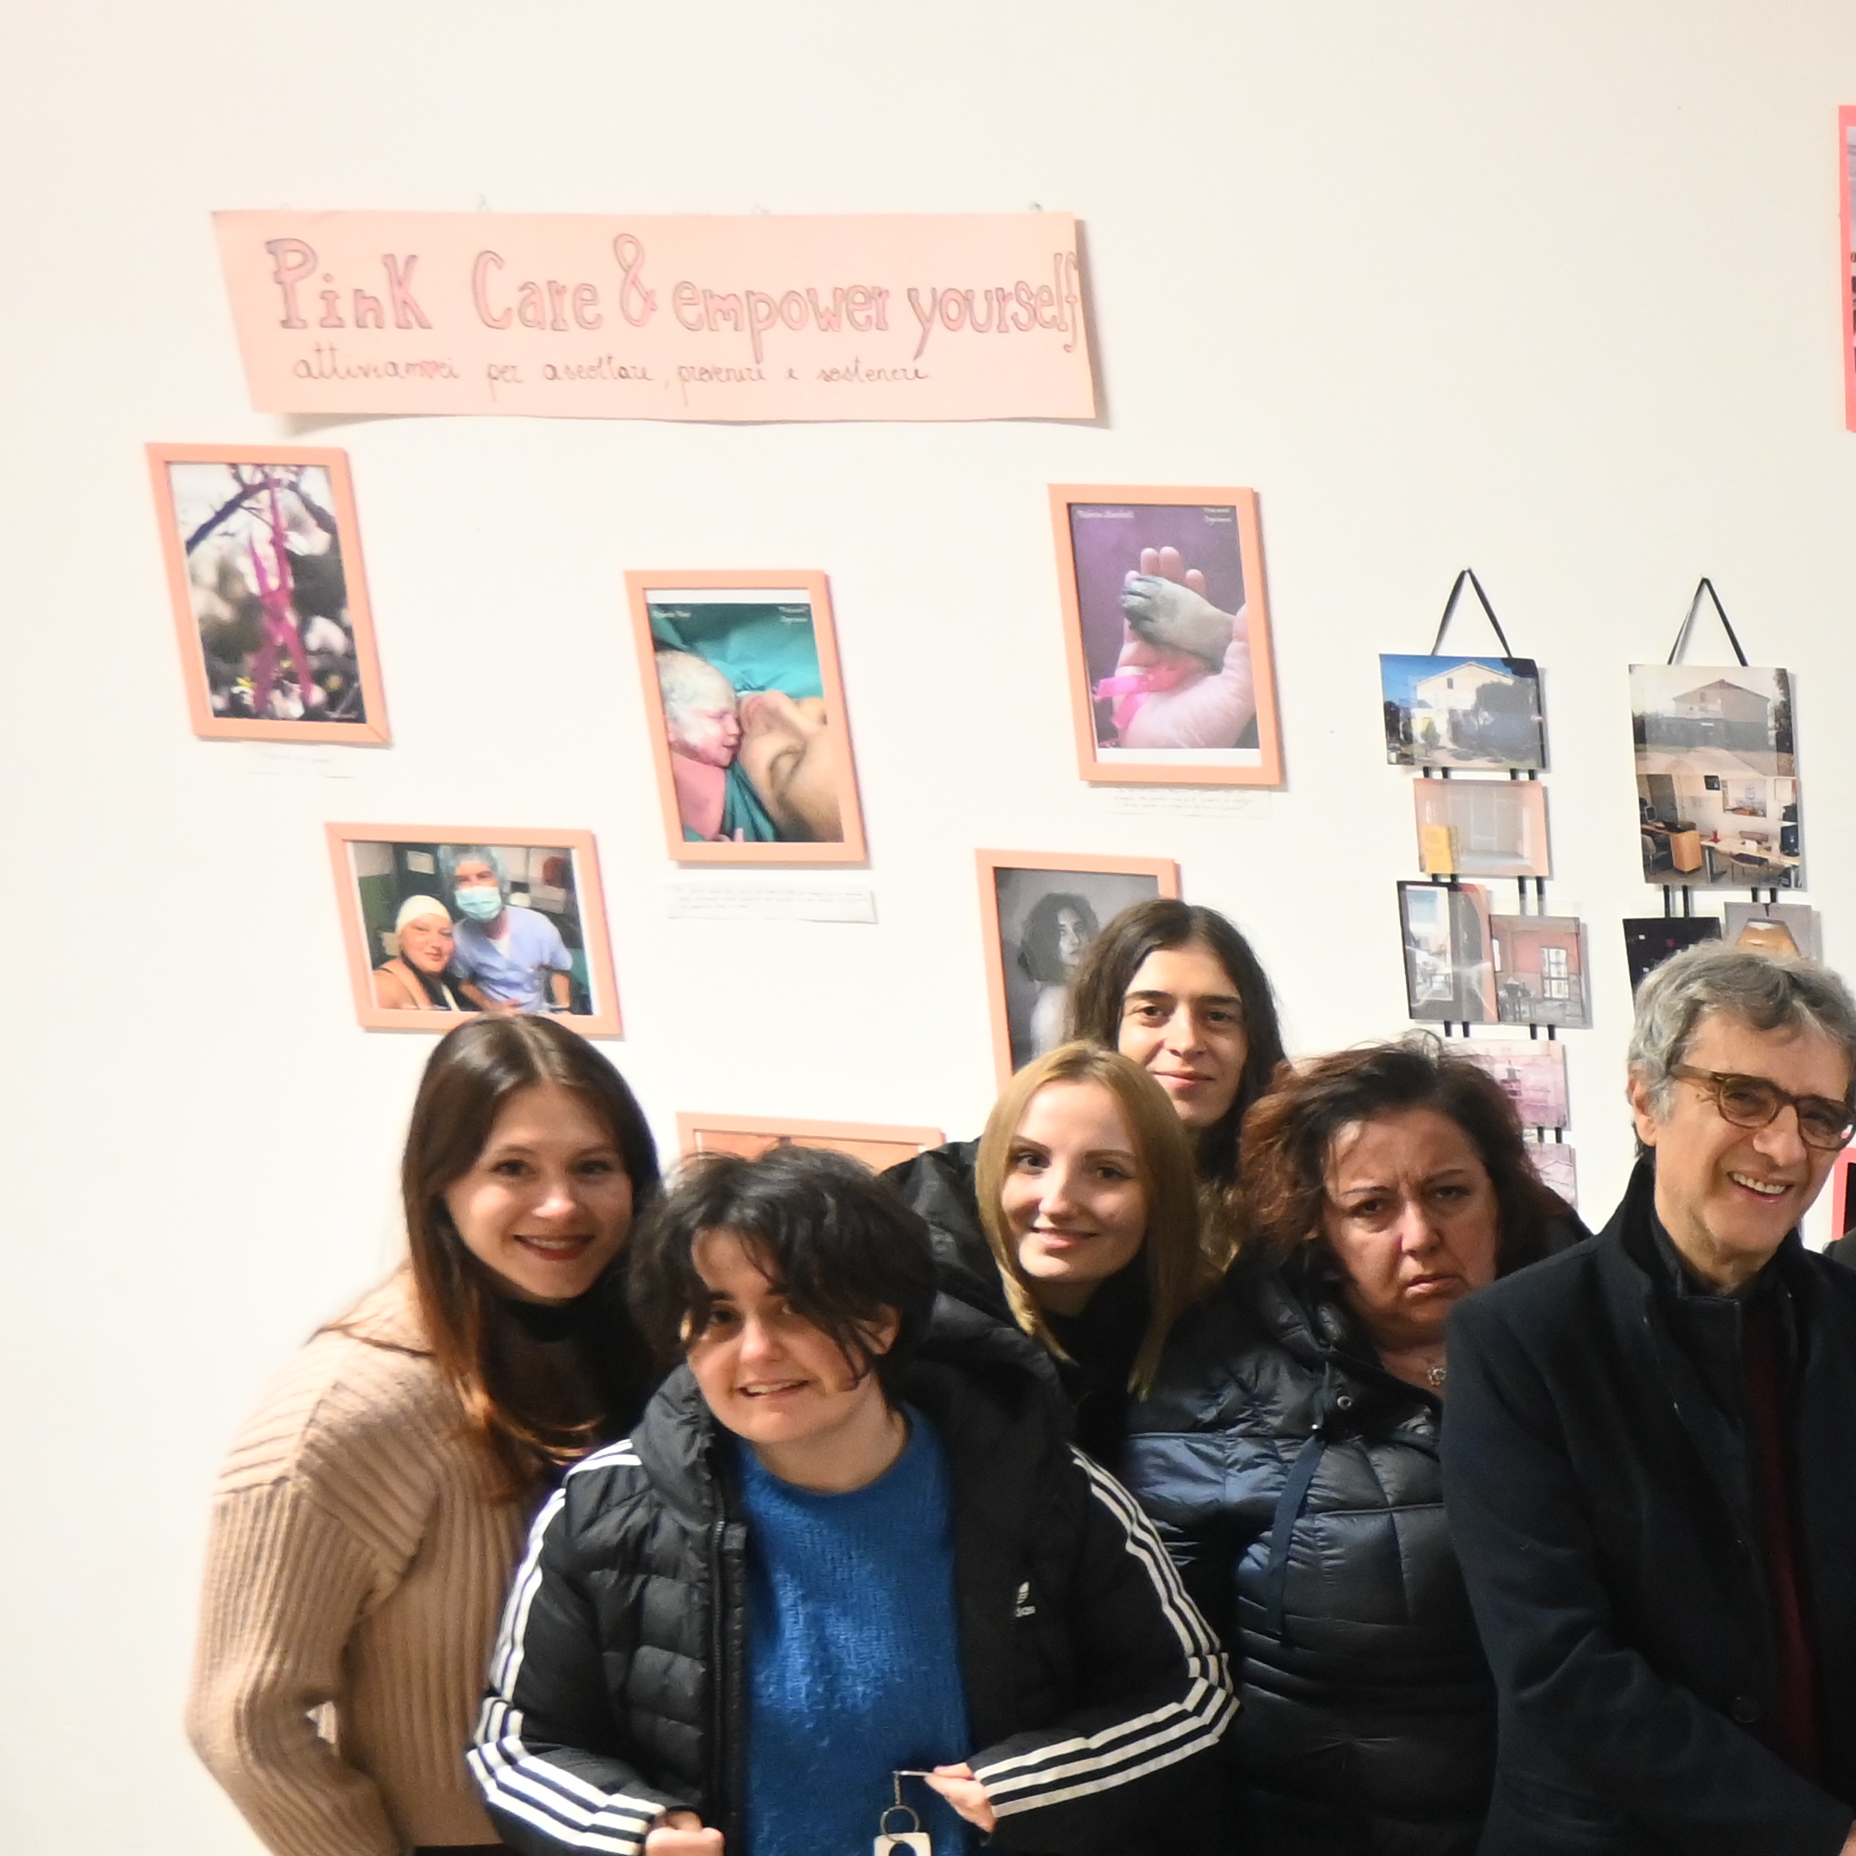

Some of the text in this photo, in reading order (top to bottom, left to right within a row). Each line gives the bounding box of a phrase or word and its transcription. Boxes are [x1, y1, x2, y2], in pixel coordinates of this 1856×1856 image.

[471, 249, 604, 332] Care
[612, 232, 658, 328] &
[673, 280, 890, 364] empower
[908, 250, 1078, 353] yourself
[816, 356, 930, 383] sostenere
